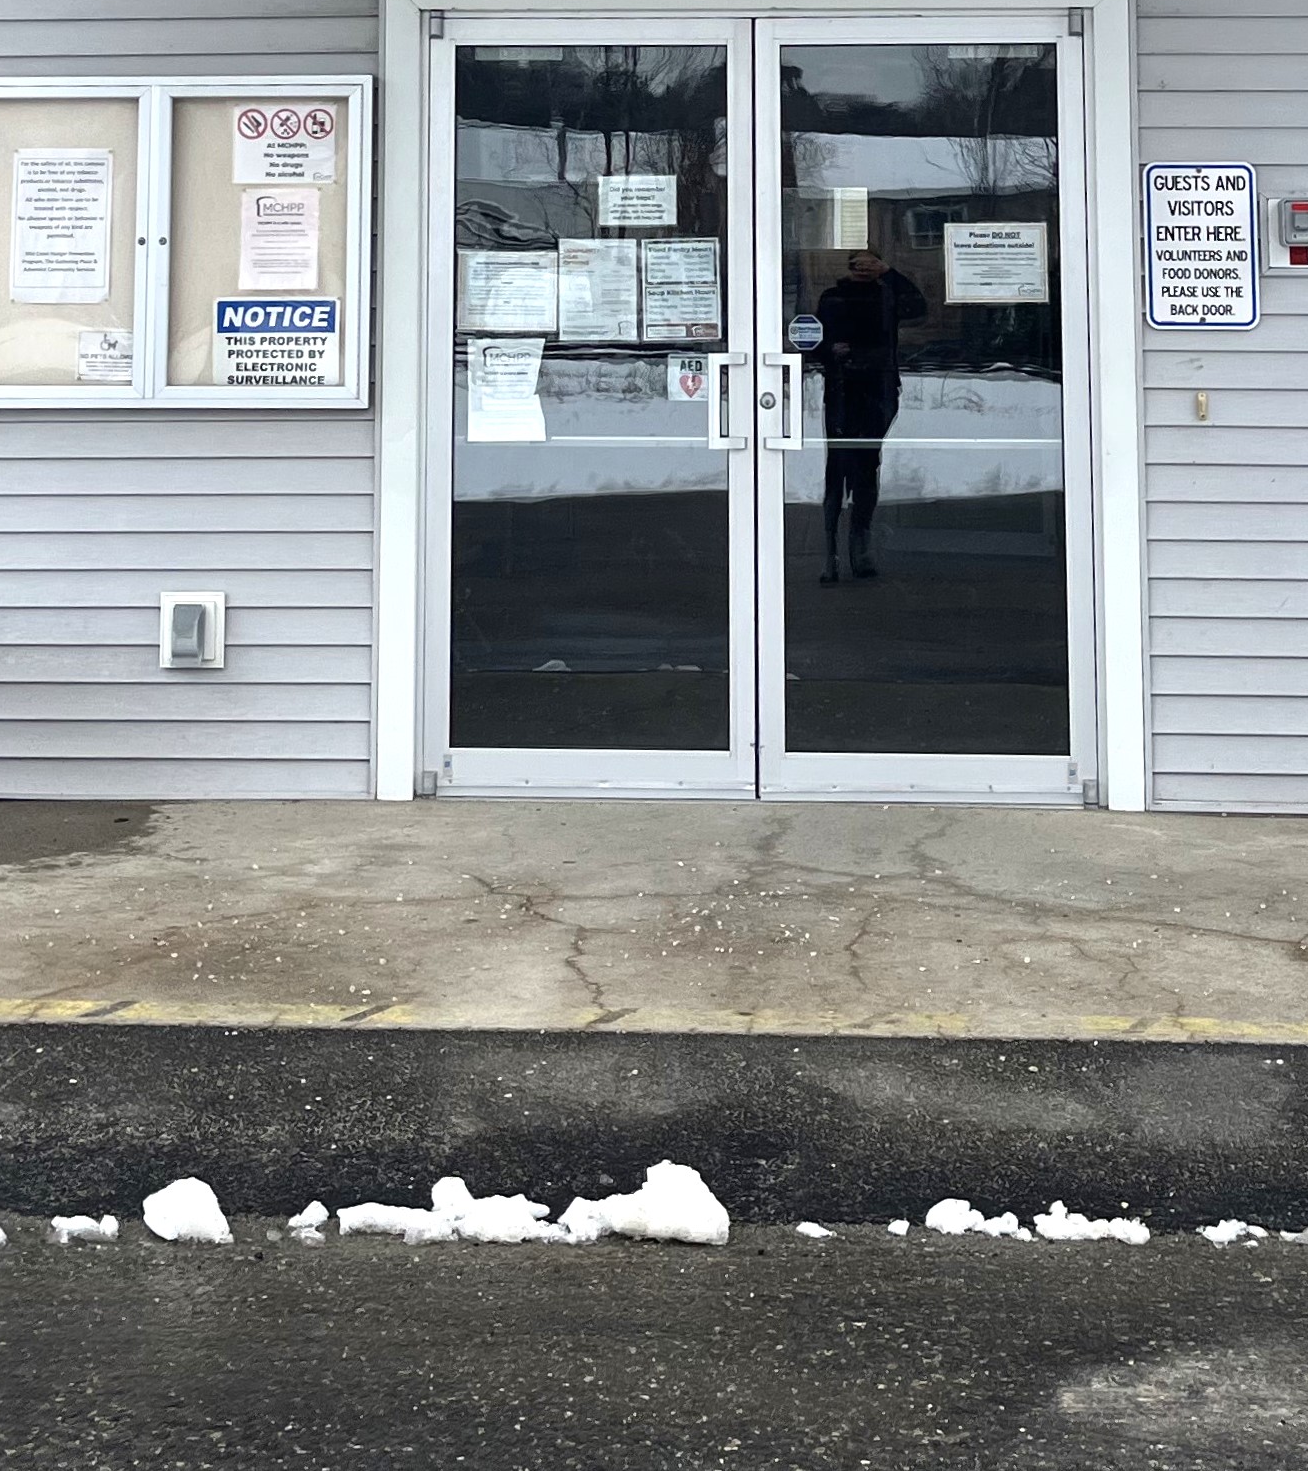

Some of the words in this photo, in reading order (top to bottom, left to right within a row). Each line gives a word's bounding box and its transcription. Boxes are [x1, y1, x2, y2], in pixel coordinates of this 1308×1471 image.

[1154, 176, 1210, 191] GUESTS
[1215, 176, 1246, 191] AND
[263, 203, 304, 212] MCHPP
[1168, 201, 1234, 216] VISITORS
[1156, 226, 1201, 241] ENTER
[1207, 226, 1246, 241] HERE.
[1156, 250, 1222, 261] VOLUNTEERS
[1226, 250, 1248, 261] AND
[1162, 268, 1191, 279] FOOD
[1161, 286, 1198, 297] PLEASE
[1201, 286, 1221, 297] USE
[1224, 286, 1243, 298] THE
[1170, 304, 1199, 315] BACK
[1202, 304, 1235, 315] DOOR.
[223, 307, 330, 327] NOTICE
[225, 337, 255, 345] THIS
[260, 337, 327, 345] PROPERTY
[228, 350, 304, 358] PROTECTED
[308, 350, 325, 358] BY
[236, 362, 317, 371] ELECTRONIC
[680, 360, 702, 371] AED
[227, 376, 325, 385] SURVEILLANCE
